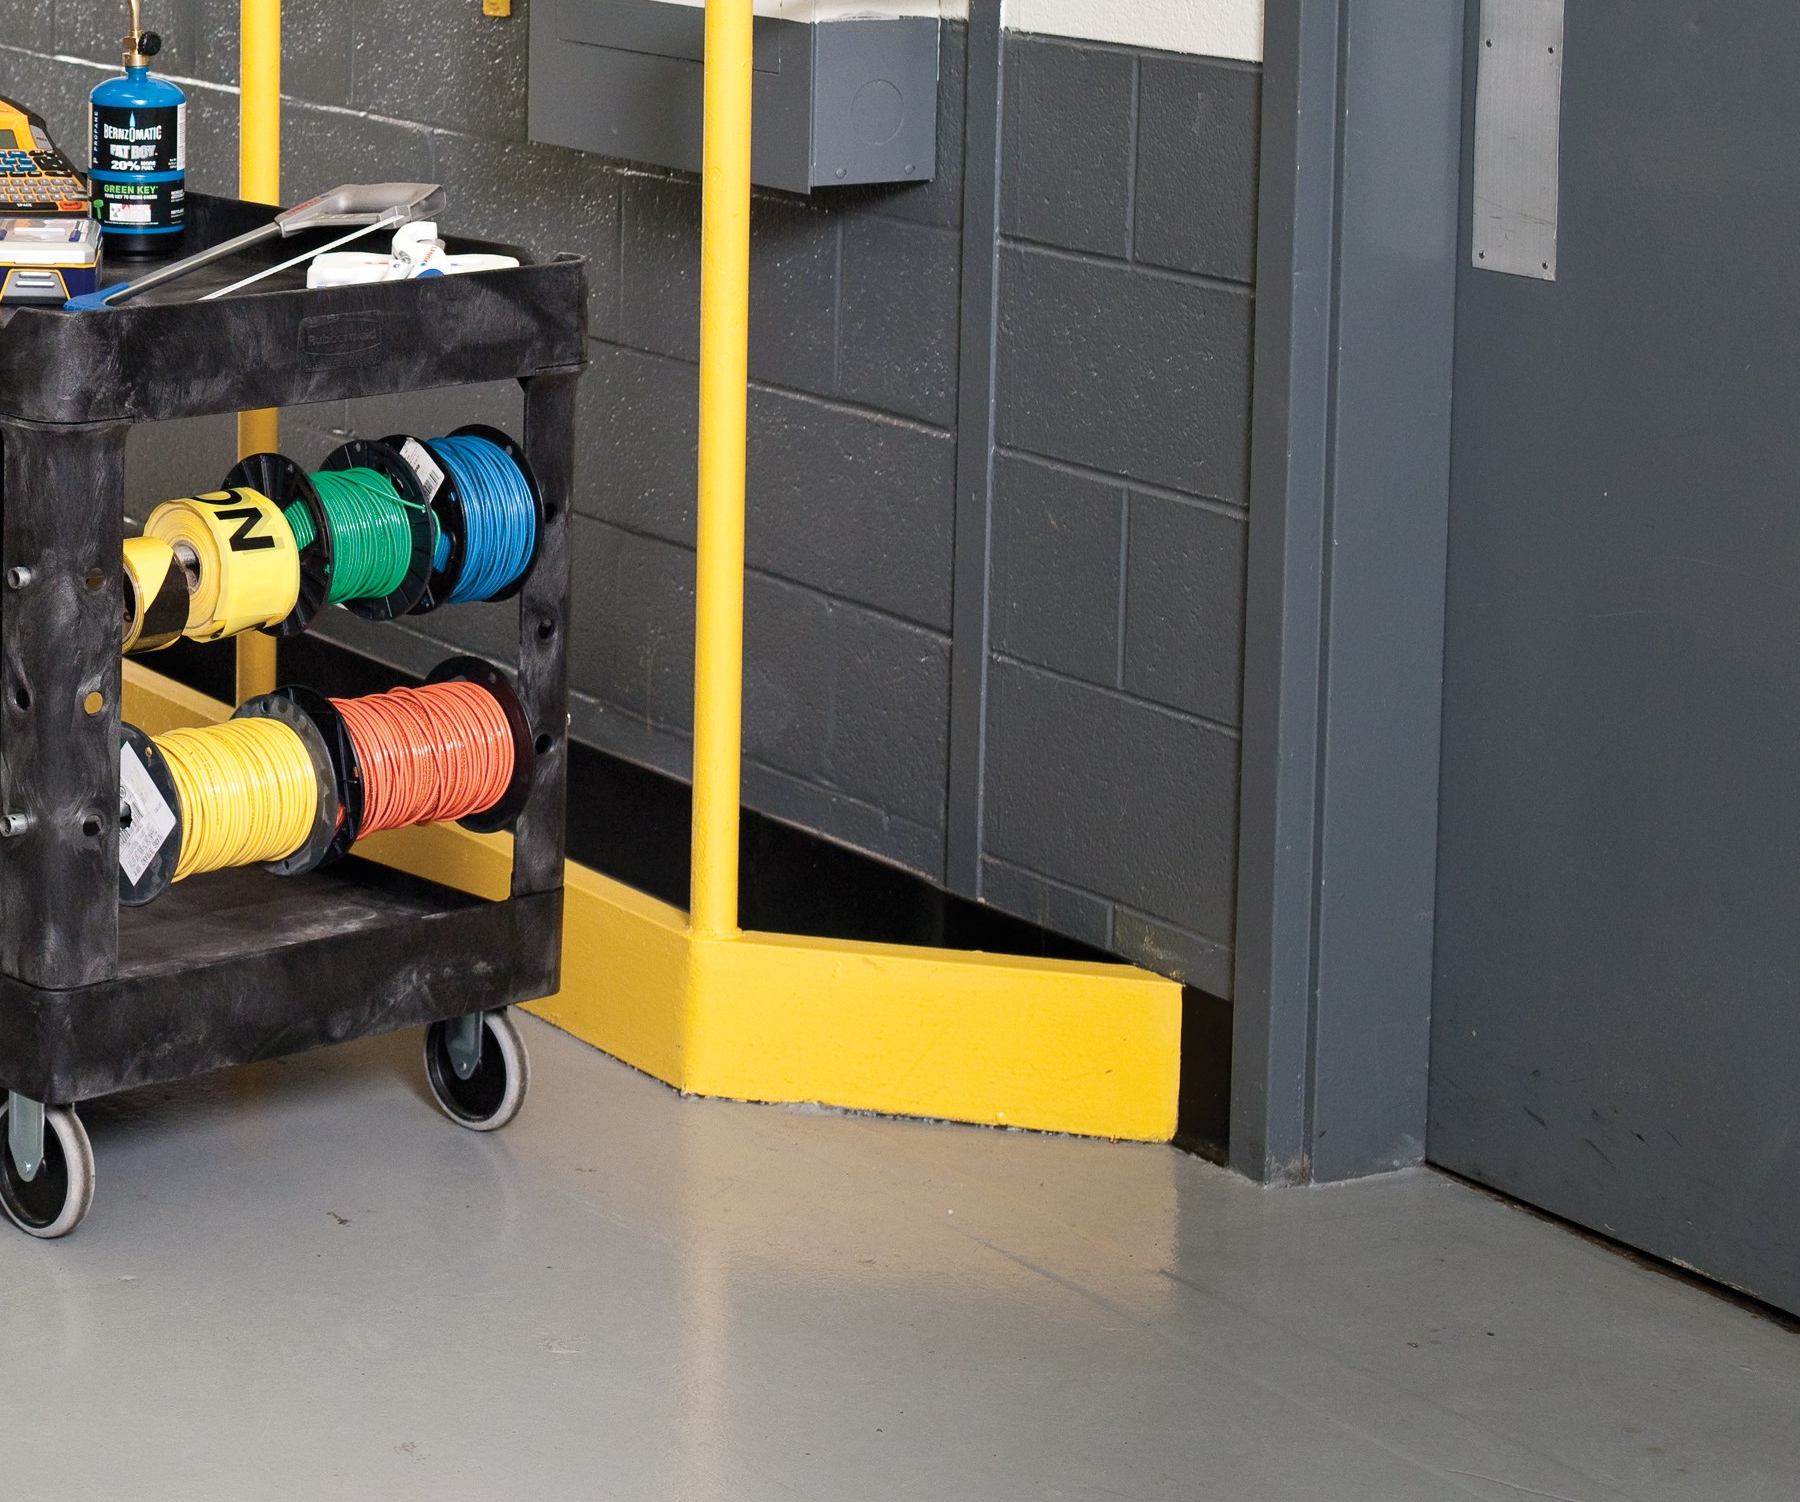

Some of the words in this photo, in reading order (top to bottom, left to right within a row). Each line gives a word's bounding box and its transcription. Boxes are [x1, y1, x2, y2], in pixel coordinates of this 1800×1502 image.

[103, 123, 162, 143] BERNZOMATIC
[109, 144, 130, 159] FAT
[111, 160, 141, 171] 20%
[103, 184, 134, 194] GREEN
[136, 185, 156, 194] KEY
